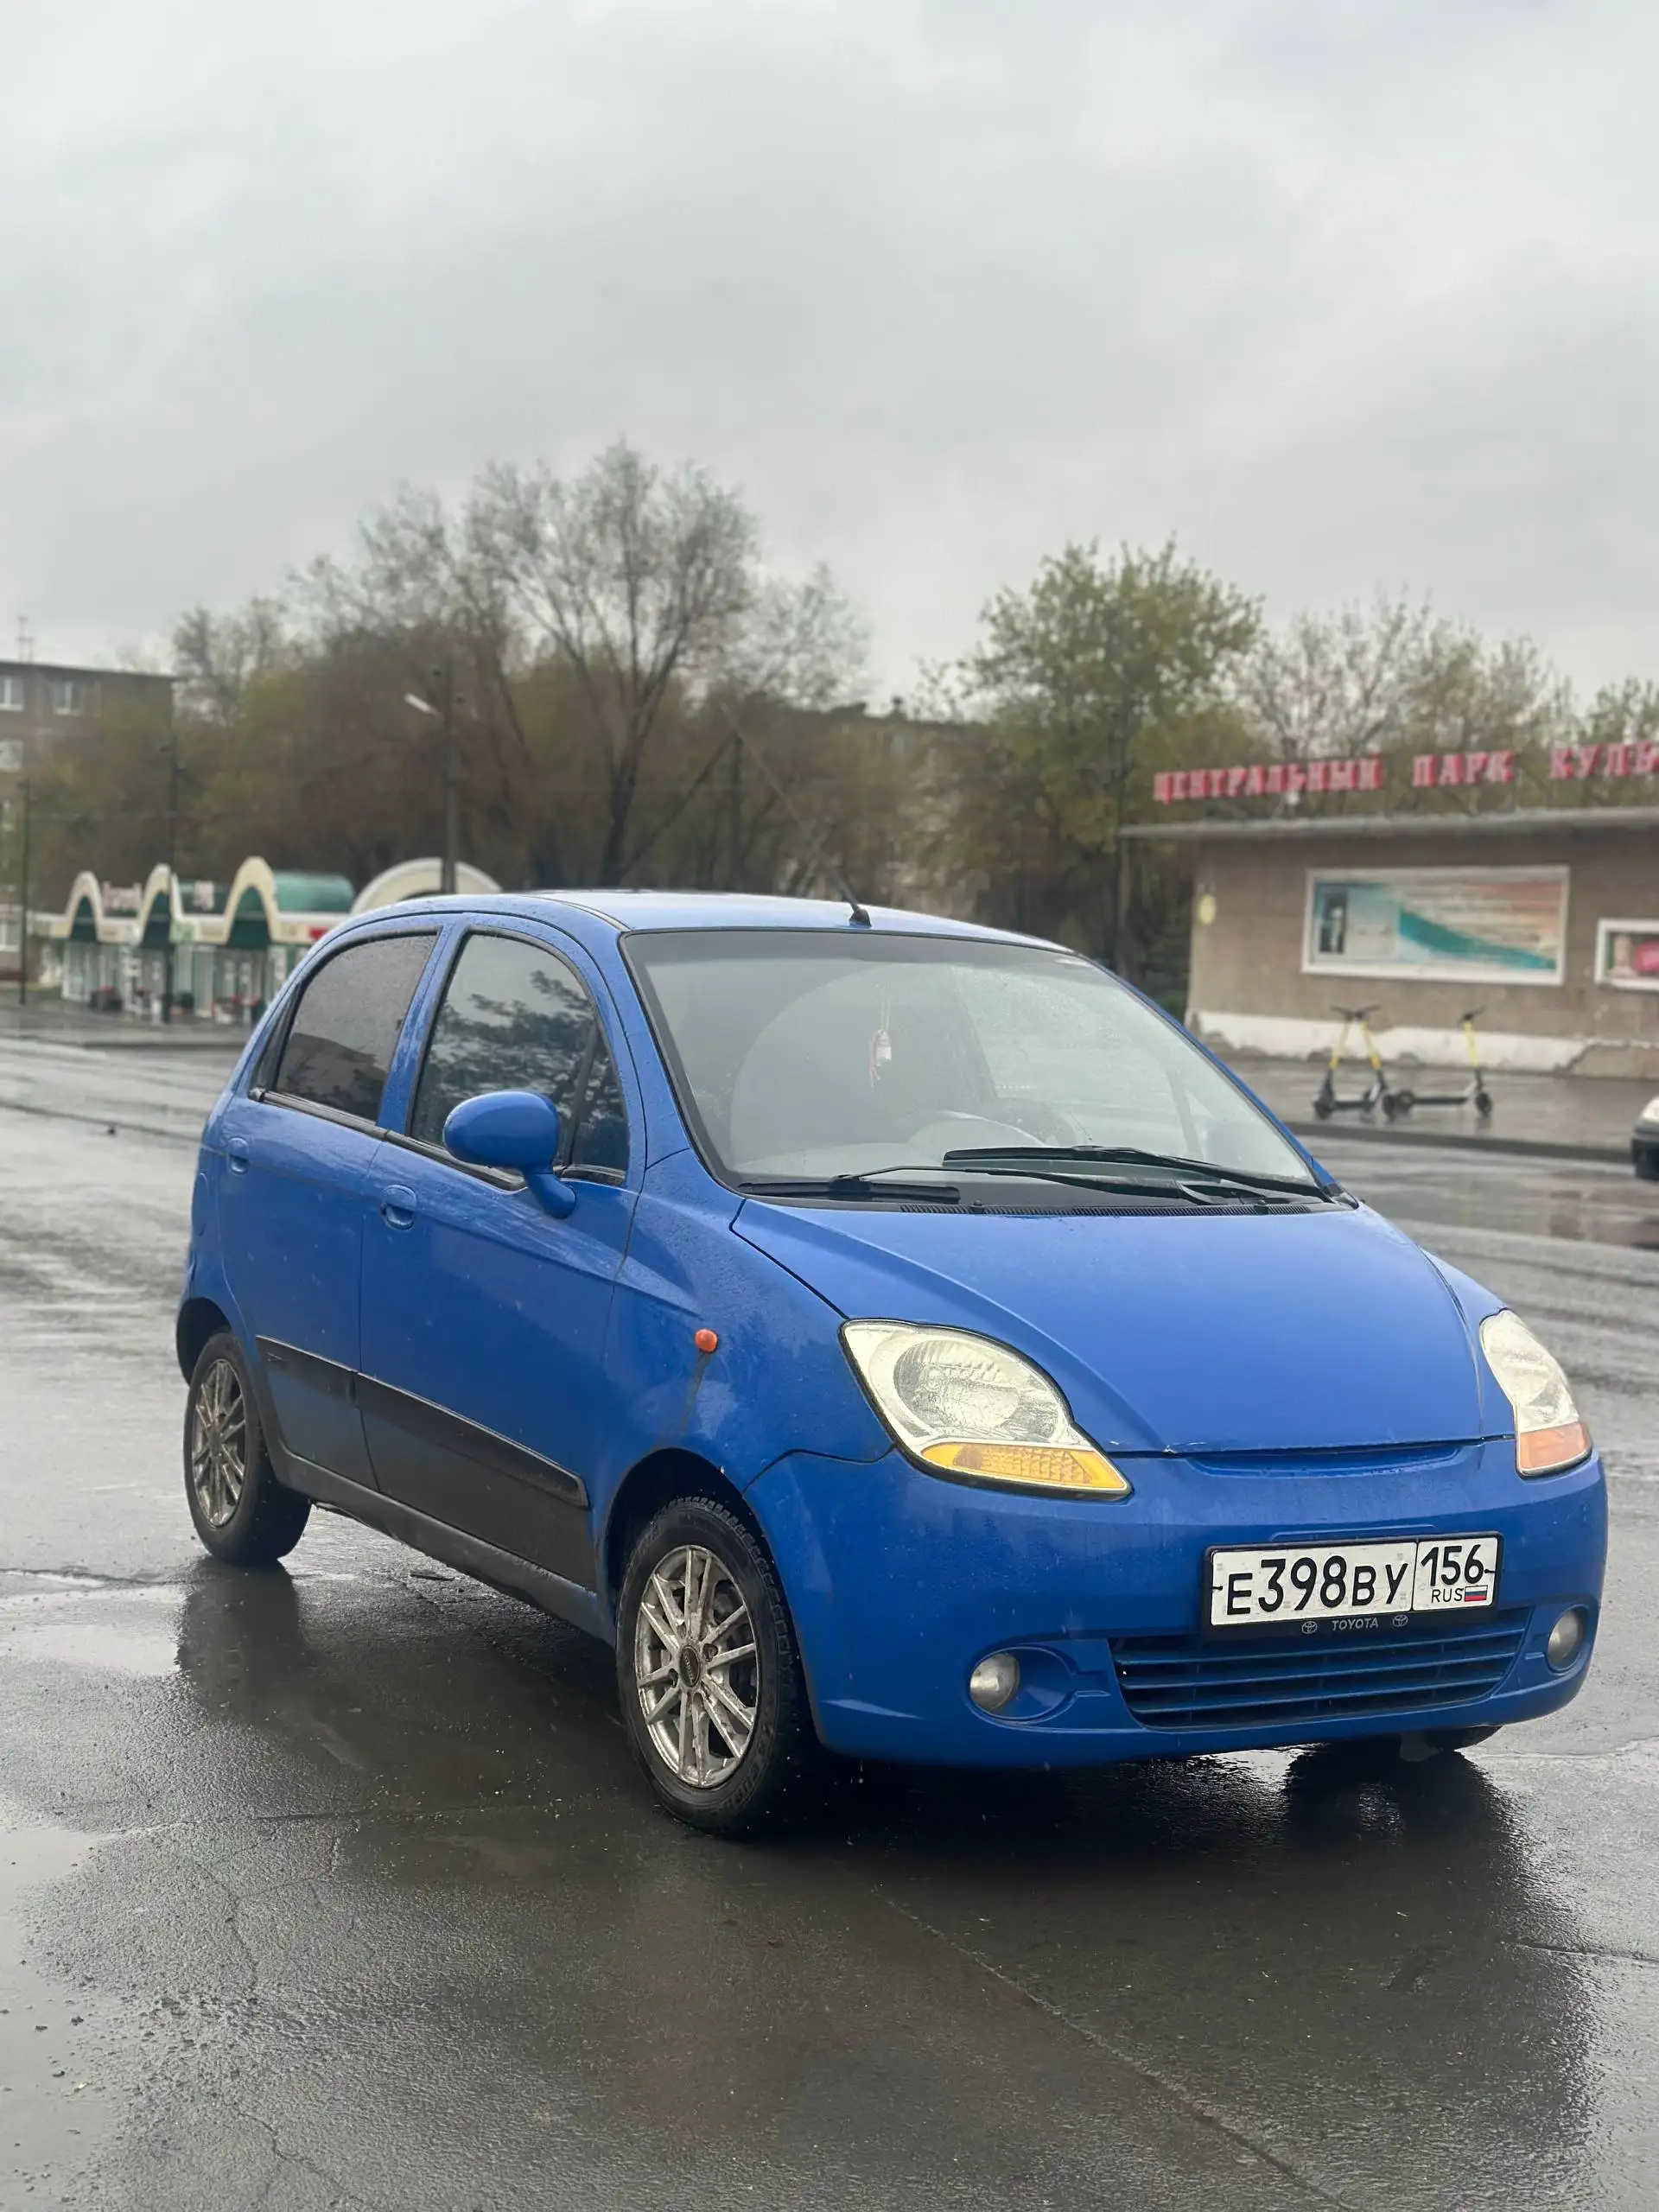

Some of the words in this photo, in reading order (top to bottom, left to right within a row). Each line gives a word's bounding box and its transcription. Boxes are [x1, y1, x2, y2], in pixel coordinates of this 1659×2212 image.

[1153, 753, 1380, 806] ЦЕНТРАЛЬНЫЙ
[1413, 750, 1515, 787] ПАРК
[1421, 1544, 1484, 1587] 156
[1431, 1587, 1464, 1603] RUS
[1332, 1618, 1379, 1631] TOYOTA
